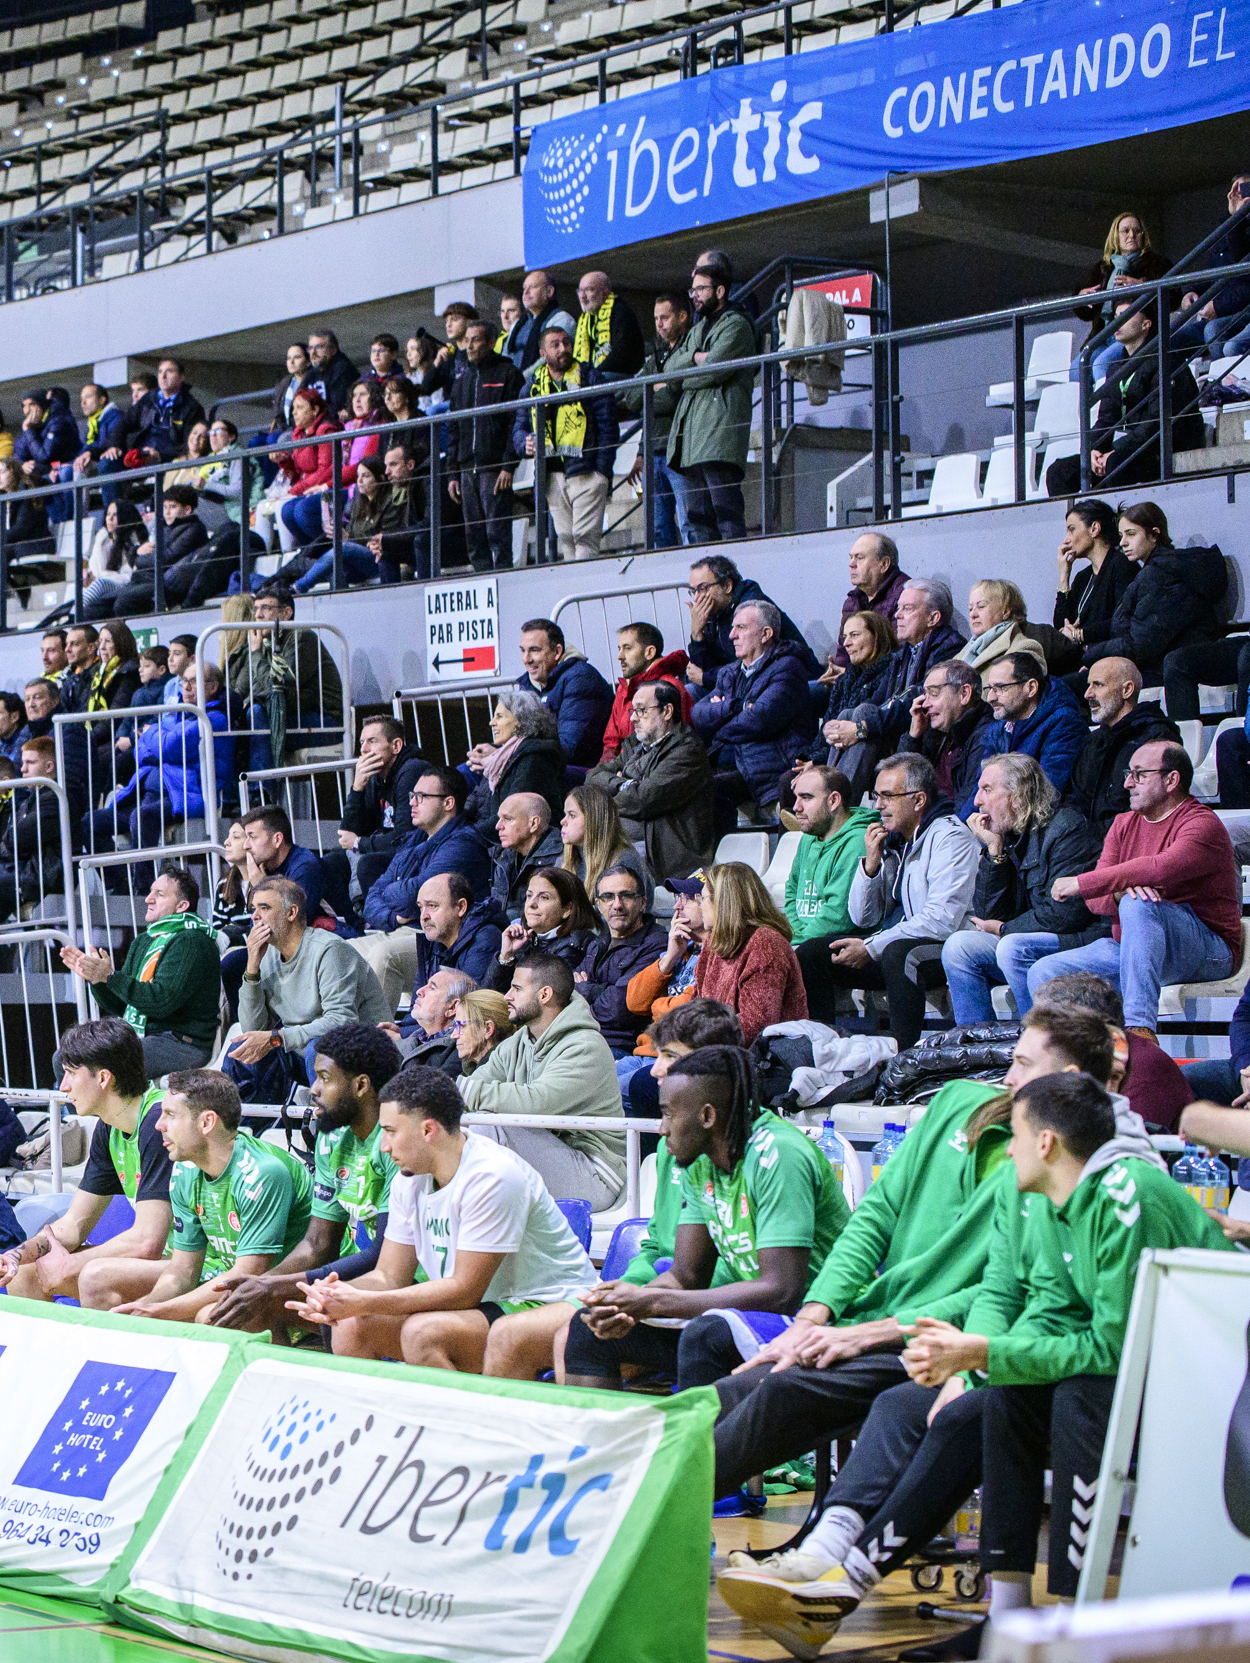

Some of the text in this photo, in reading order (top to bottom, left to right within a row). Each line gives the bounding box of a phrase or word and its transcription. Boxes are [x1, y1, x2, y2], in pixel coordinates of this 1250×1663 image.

[881, 6, 1236, 140] CONECTANDO EL
[606, 79, 823, 224] ibertic
[851, 287, 862, 304] A
[427, 587, 494, 615] LATERAL A
[429, 618, 494, 645] PAR PISTA
[66, 1431, 105, 1452] HOTEL
[339, 1425, 616, 1558] ibertic
[26, 1524, 55, 1548] 34
[342, 1571, 455, 1624] telecom
